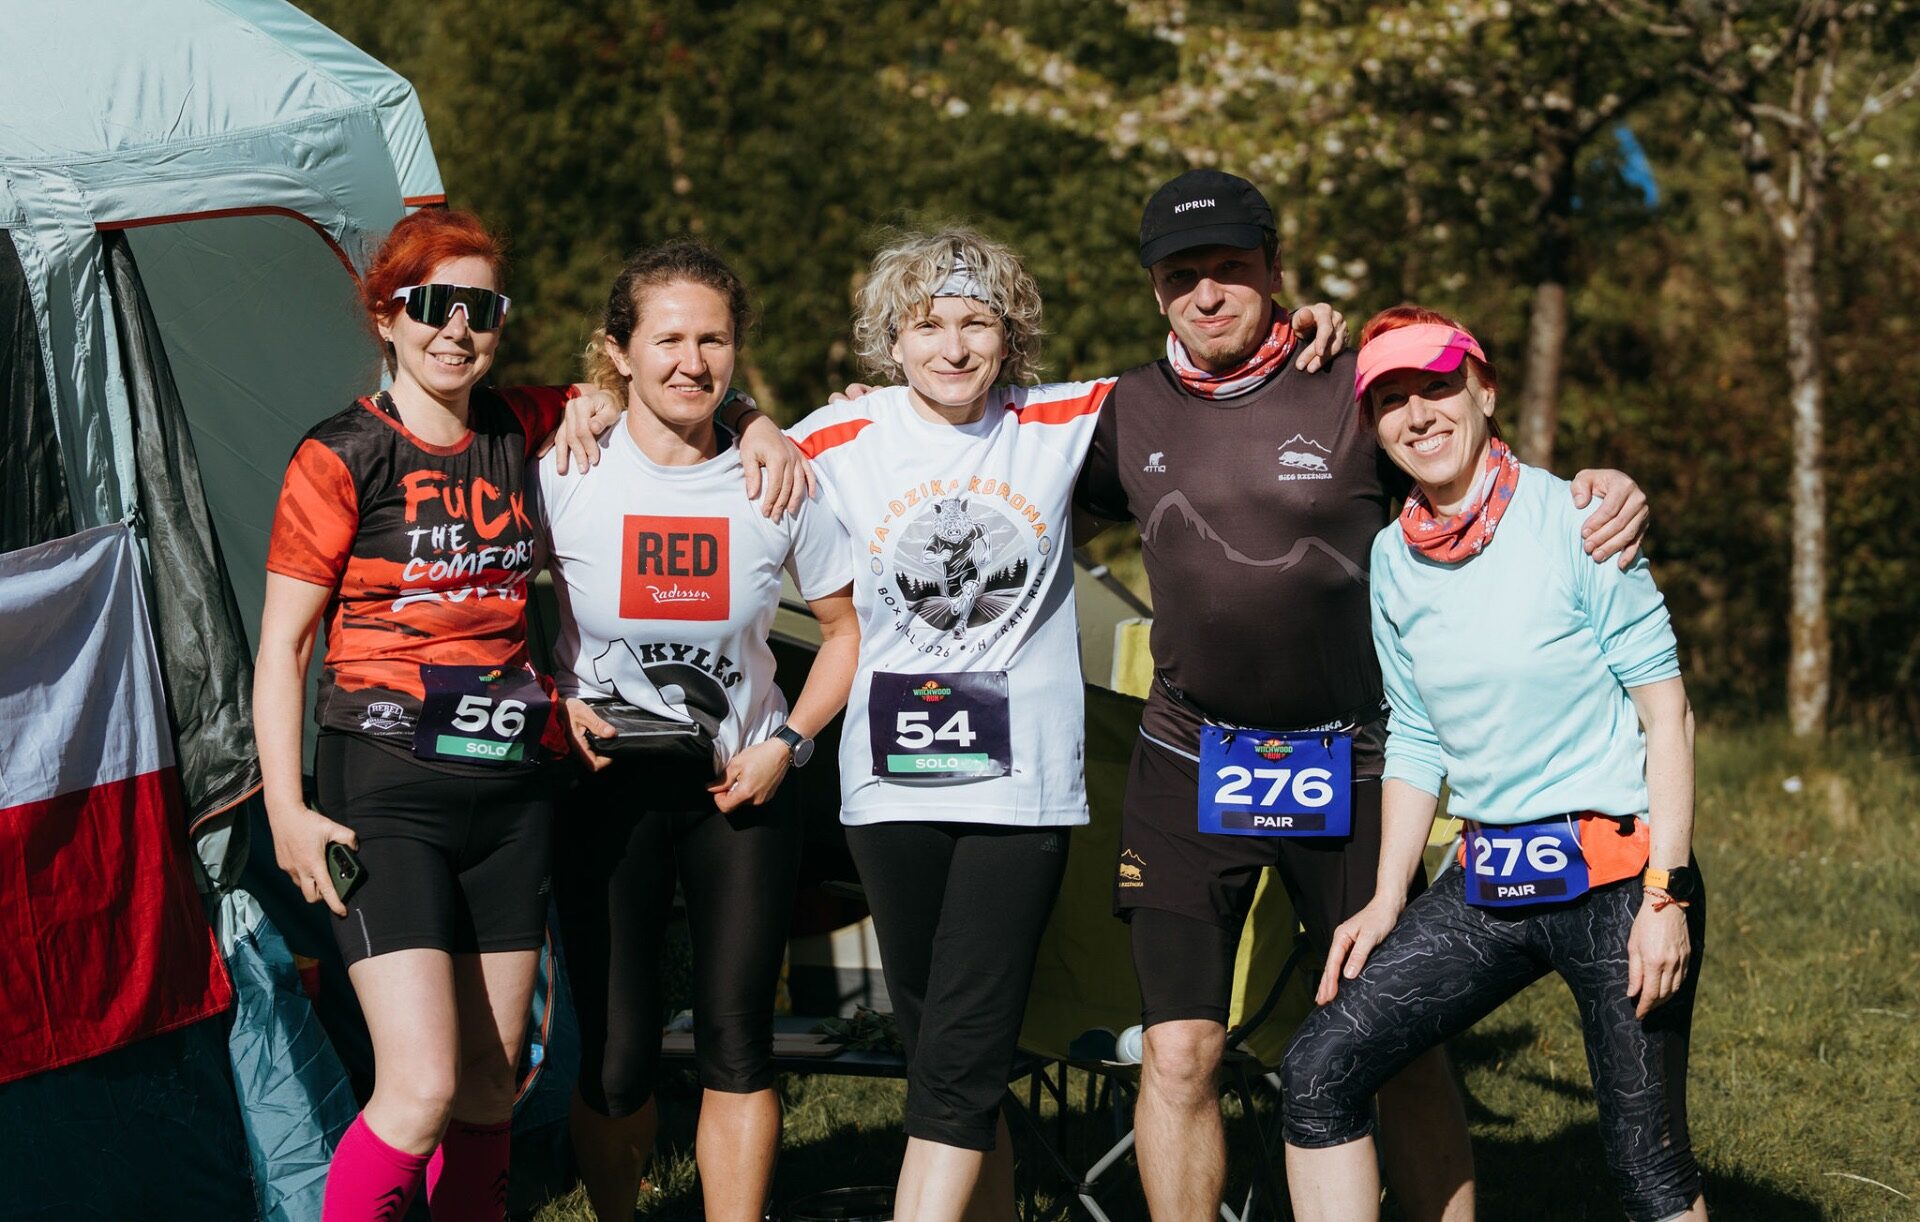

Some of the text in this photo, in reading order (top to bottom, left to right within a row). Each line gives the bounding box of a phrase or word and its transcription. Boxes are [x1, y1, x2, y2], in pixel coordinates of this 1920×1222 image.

[1174, 198, 1216, 214] KIPRUN
[968, 474, 1048, 539] KORONA
[405, 524, 469, 557] THE
[638, 531, 718, 577] RED
[402, 540, 534, 582] COMFORT
[645, 583, 711, 604] Radisson
[877, 587, 902, 617] BOX
[917, 642, 951, 658] 2026
[994, 607, 1030, 640] TRAIL
[639, 642, 743, 689] KYLES
[451, 694, 528, 738] 56
[896, 710, 977, 749] 54
[466, 742, 507, 757] SOLO
[915, 757, 959, 769] SOLO
[1254, 745, 1293, 754] WITCHWOOD
[1214, 765, 1334, 808] 276
[1253, 815, 1294, 828] PAIR
[1473, 836, 1568, 877] 276
[1497, 884, 1536, 898] PAIR
